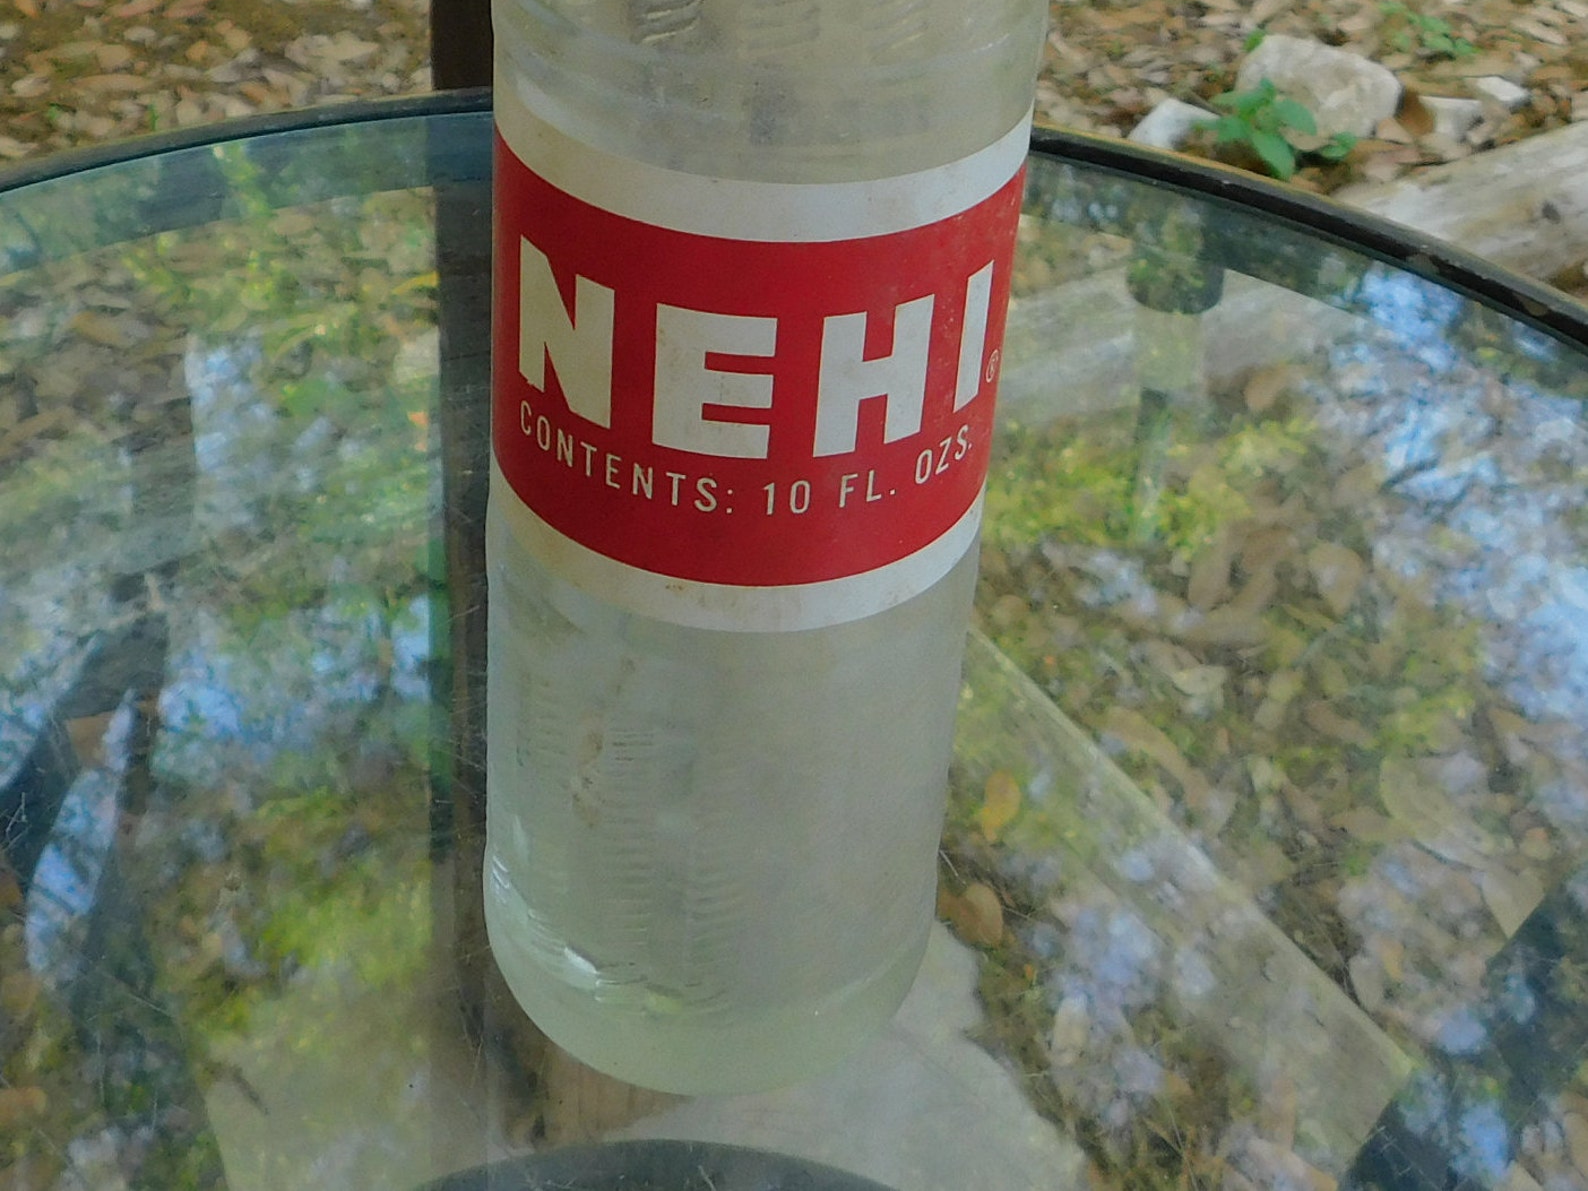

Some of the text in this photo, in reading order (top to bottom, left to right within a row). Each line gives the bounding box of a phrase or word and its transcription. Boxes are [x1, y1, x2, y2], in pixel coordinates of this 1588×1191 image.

[518, 234, 994, 459] NEHI
[520, 400, 973, 516] CONTENTS: 10 FL. OZS.
